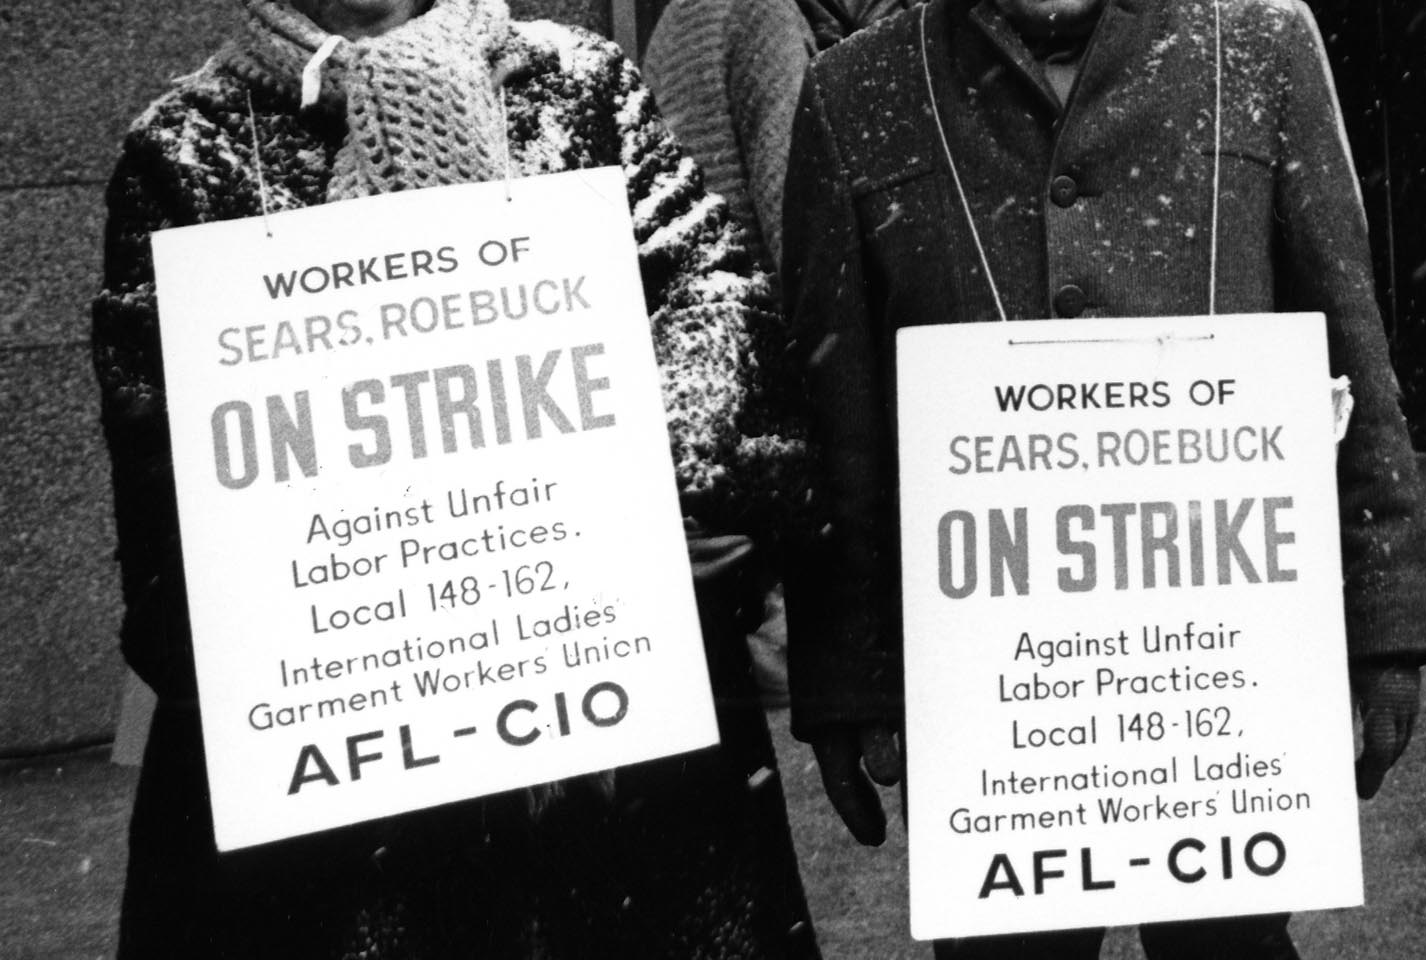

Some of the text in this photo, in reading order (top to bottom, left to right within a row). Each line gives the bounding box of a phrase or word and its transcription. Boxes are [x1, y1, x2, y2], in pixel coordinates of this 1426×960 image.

[263, 237, 529, 299] WORKERS OF
[381, 275, 591, 339] ROEBUCK
[211, 340, 614, 489] ON STRIKE
[994, 379, 1235, 412] WORKERS OF
[1098, 426, 1284, 467] ROEBUCK
[307, 478, 556, 546] Against Unfair
[292, 523, 580, 588] Labor Practices.
[938, 497, 1297, 599] ON STRIKE
[311, 561, 568, 633] Local 148-162,
[281, 620, 498, 692] International
[1014, 622, 1240, 667] Against Unfair
[249, 681, 402, 730] Garment
[999, 666, 1257, 702] Labor Practices.
[1013, 706, 1242, 749] Local 148-162,
[982, 757, 1176, 796] International
[949, 804, 1086, 834] Garment
[1232, 788, 1310, 814] Union
